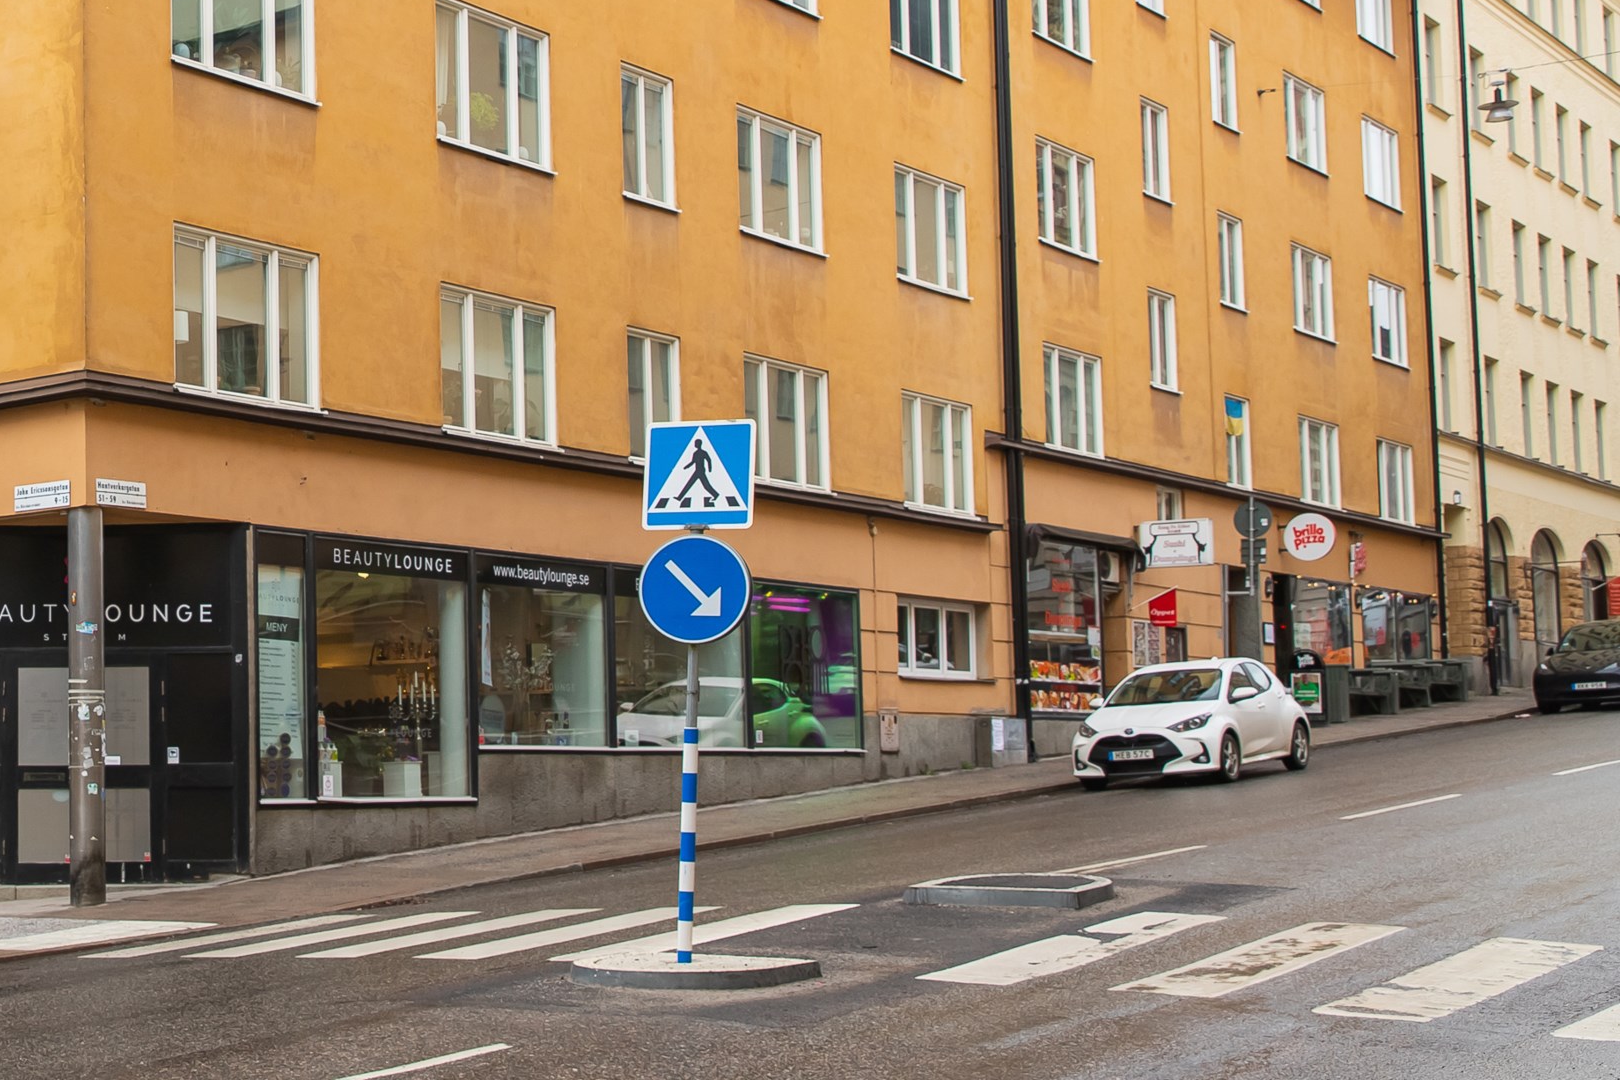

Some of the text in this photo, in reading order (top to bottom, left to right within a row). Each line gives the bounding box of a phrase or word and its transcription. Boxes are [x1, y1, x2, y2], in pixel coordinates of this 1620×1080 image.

[16, 487, 29, 497] John
[1292, 523, 1324, 538] brillo
[1293, 535, 1325, 551] pizza
[333, 548, 453, 573] BEAUTYLOUNGE
[493, 563, 590, 588] www.beautylounge.se
[266, 621, 288, 633] MENY
